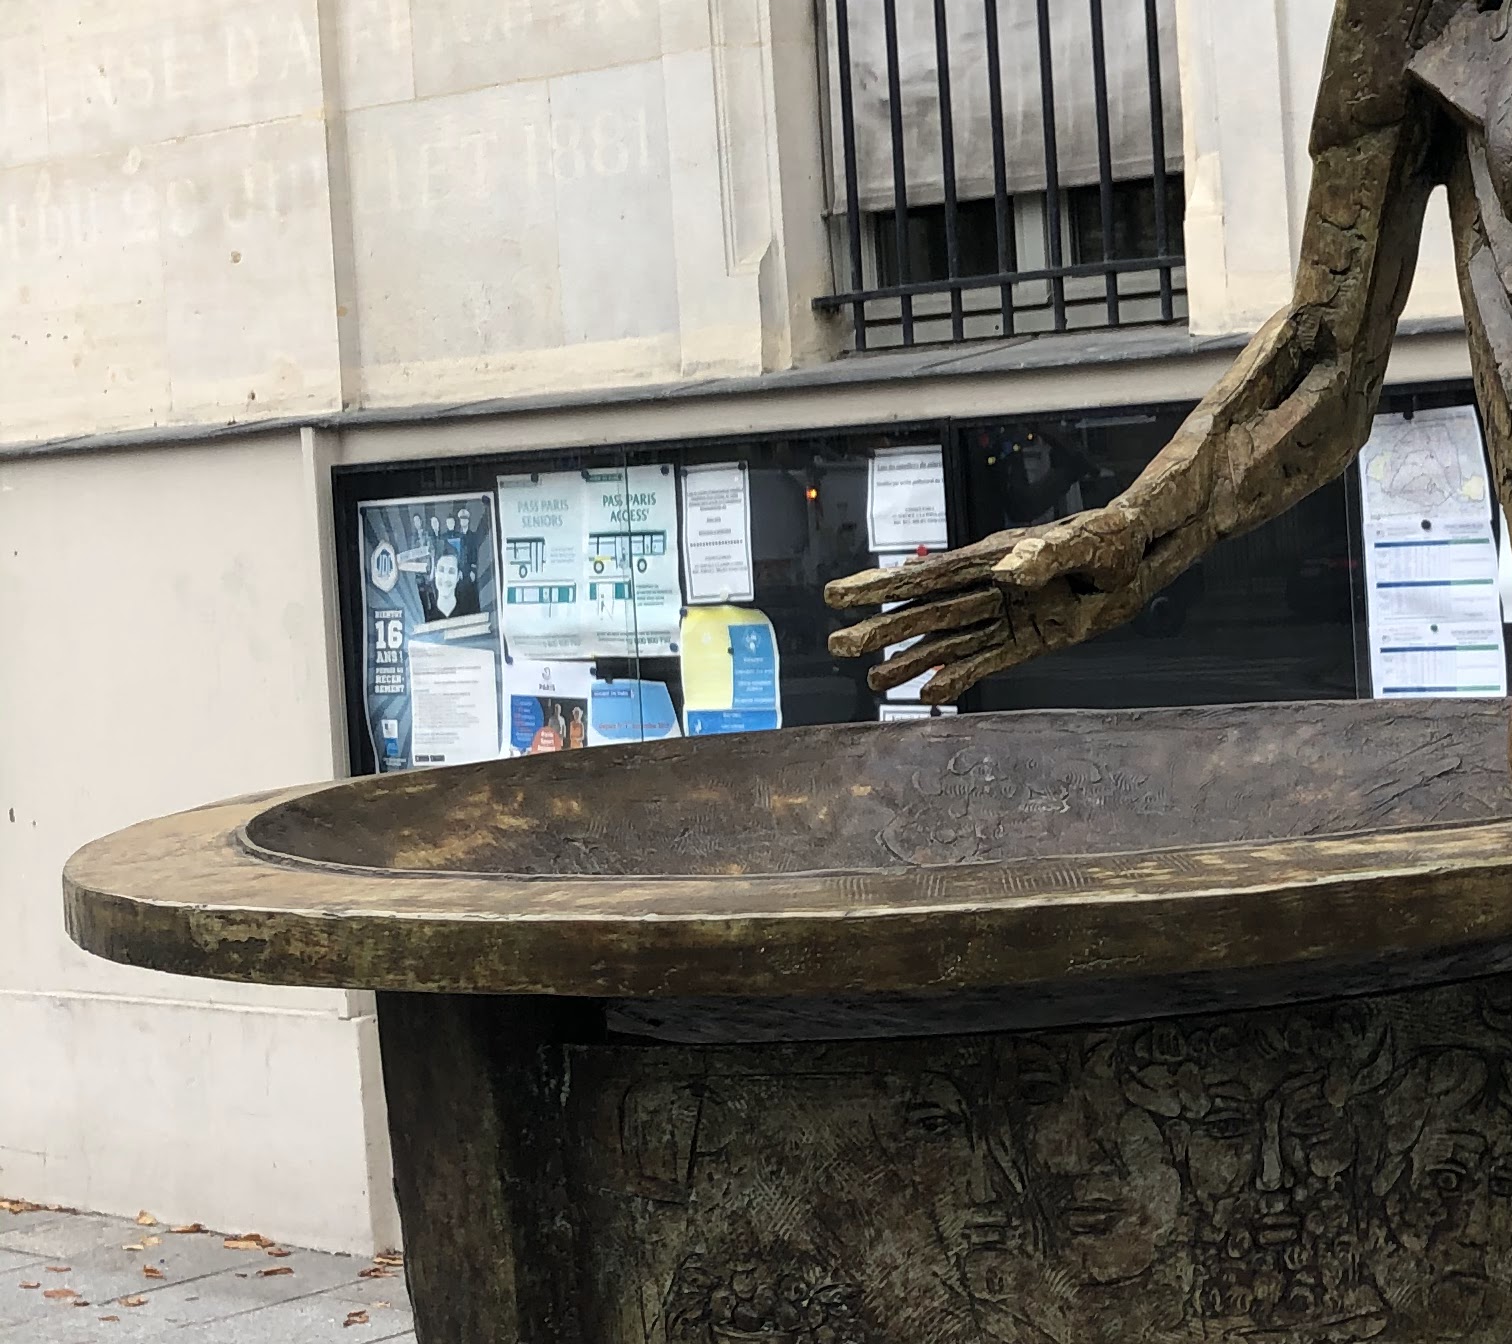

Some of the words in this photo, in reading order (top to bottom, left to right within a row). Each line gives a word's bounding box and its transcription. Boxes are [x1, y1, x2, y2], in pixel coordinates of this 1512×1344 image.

[541, 498, 569, 513] PARIS
[521, 514, 564, 529] SENIORS
[375, 620, 403, 649] 16
[376, 650, 398, 664] ANS
